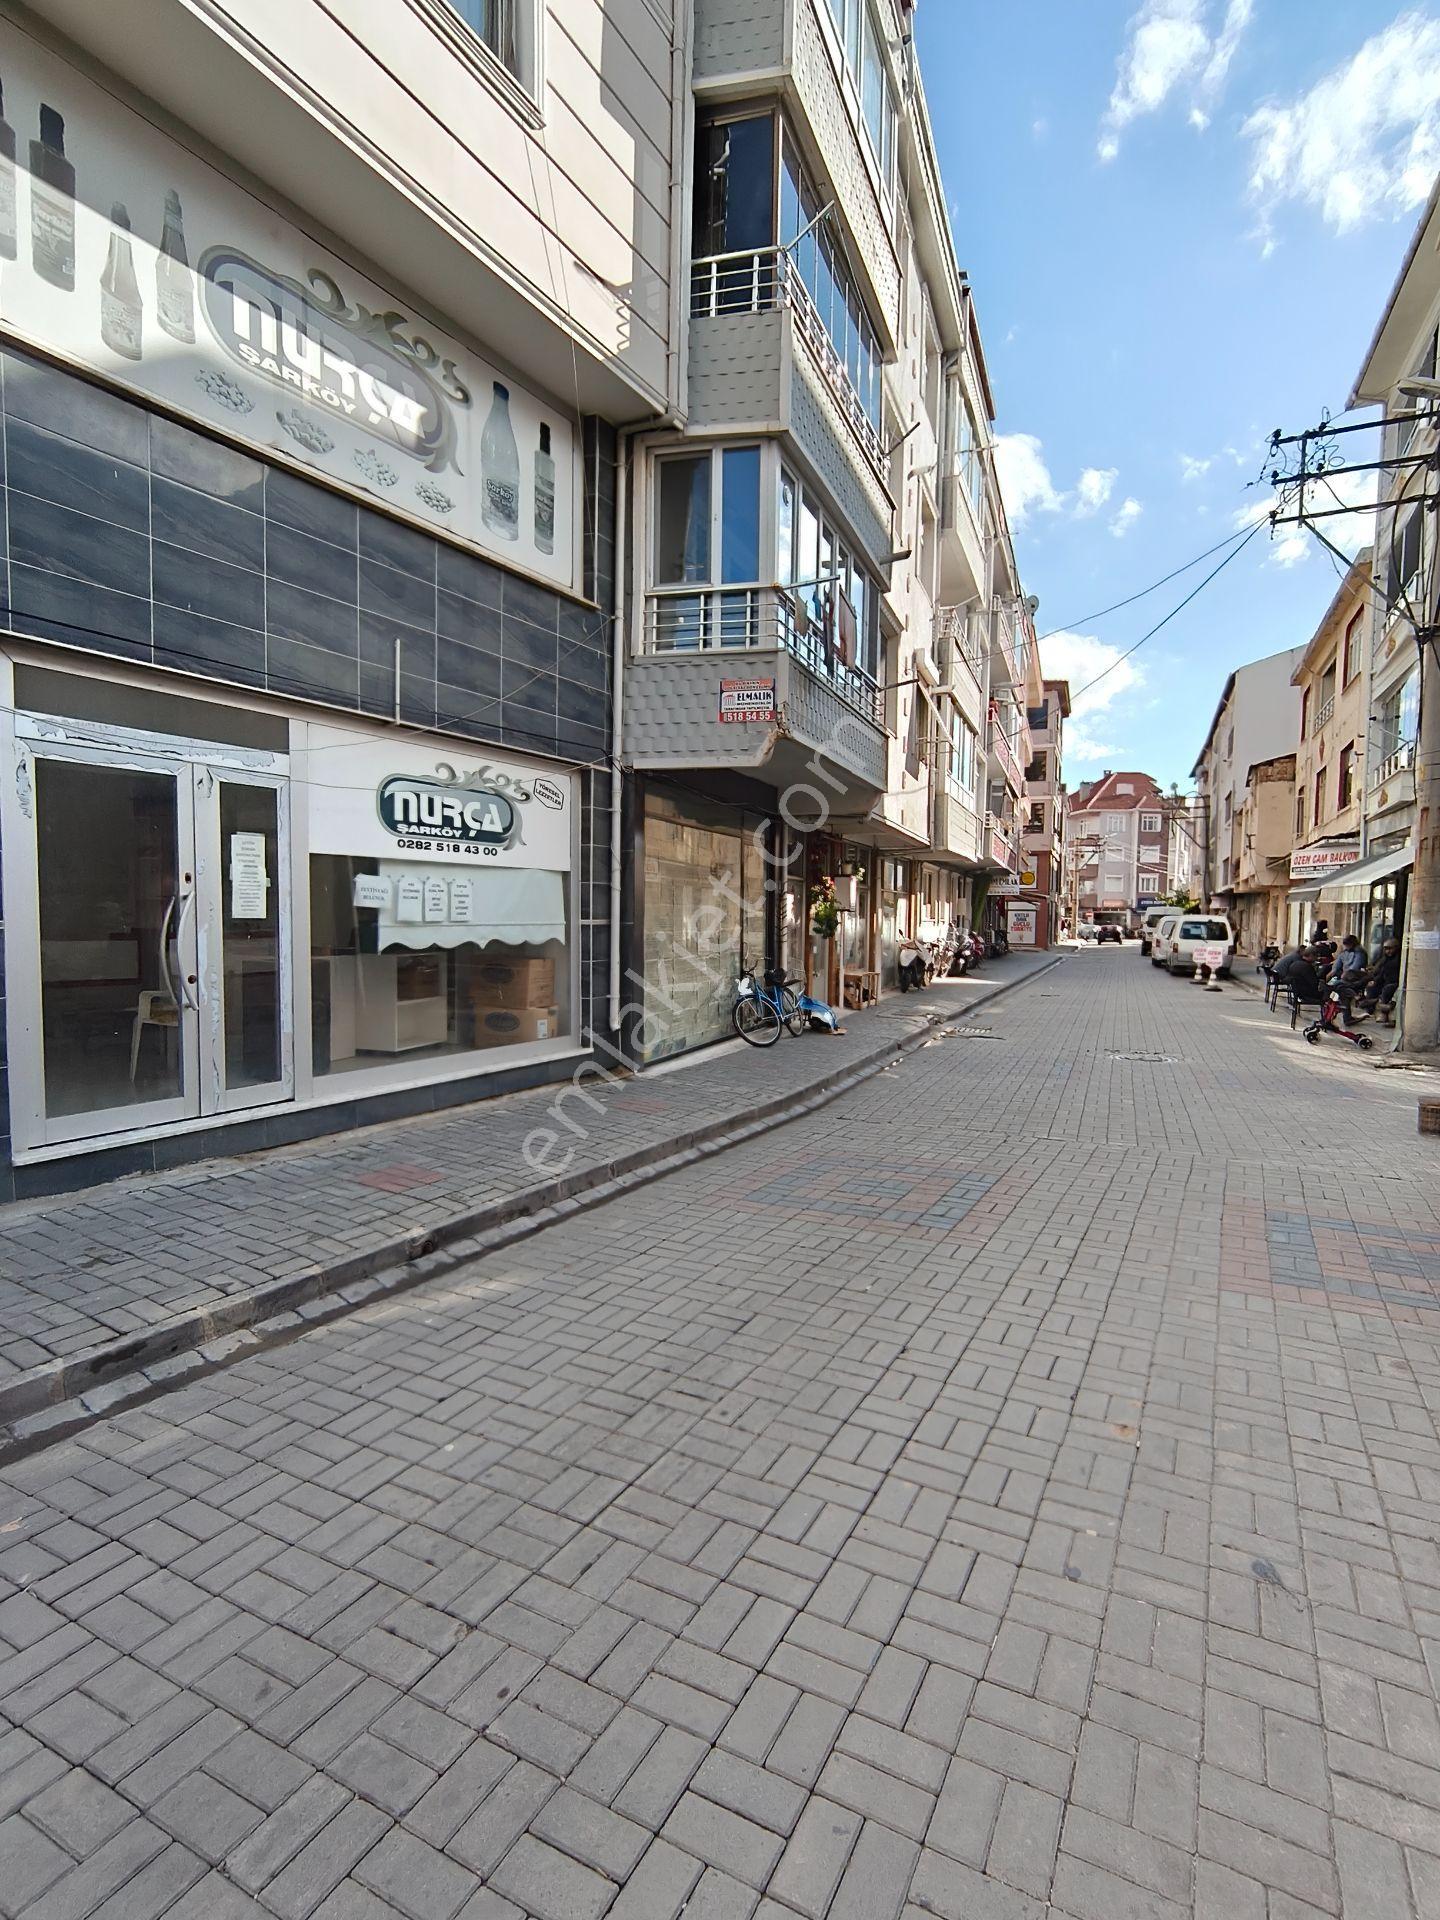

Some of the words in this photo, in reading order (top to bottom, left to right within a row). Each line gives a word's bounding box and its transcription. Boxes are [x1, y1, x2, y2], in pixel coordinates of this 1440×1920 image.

[238, 342, 356, 415] ŞARKÖY
[737, 691, 772, 701] ELMALIK
[727, 712, 744, 721] 518
[746, 711, 757, 720] 54
[759, 711, 770, 720] 55
[396, 823, 463, 838] ŞARKÖY
[397, 839, 432, 851] 0282
[436, 843, 461, 853] 518
[464, 845, 480, 855] 43
[483, 847, 498, 857] 00
[1312, 853, 1328, 864] CAM
[1329, 852, 1358, 863] BALKON
